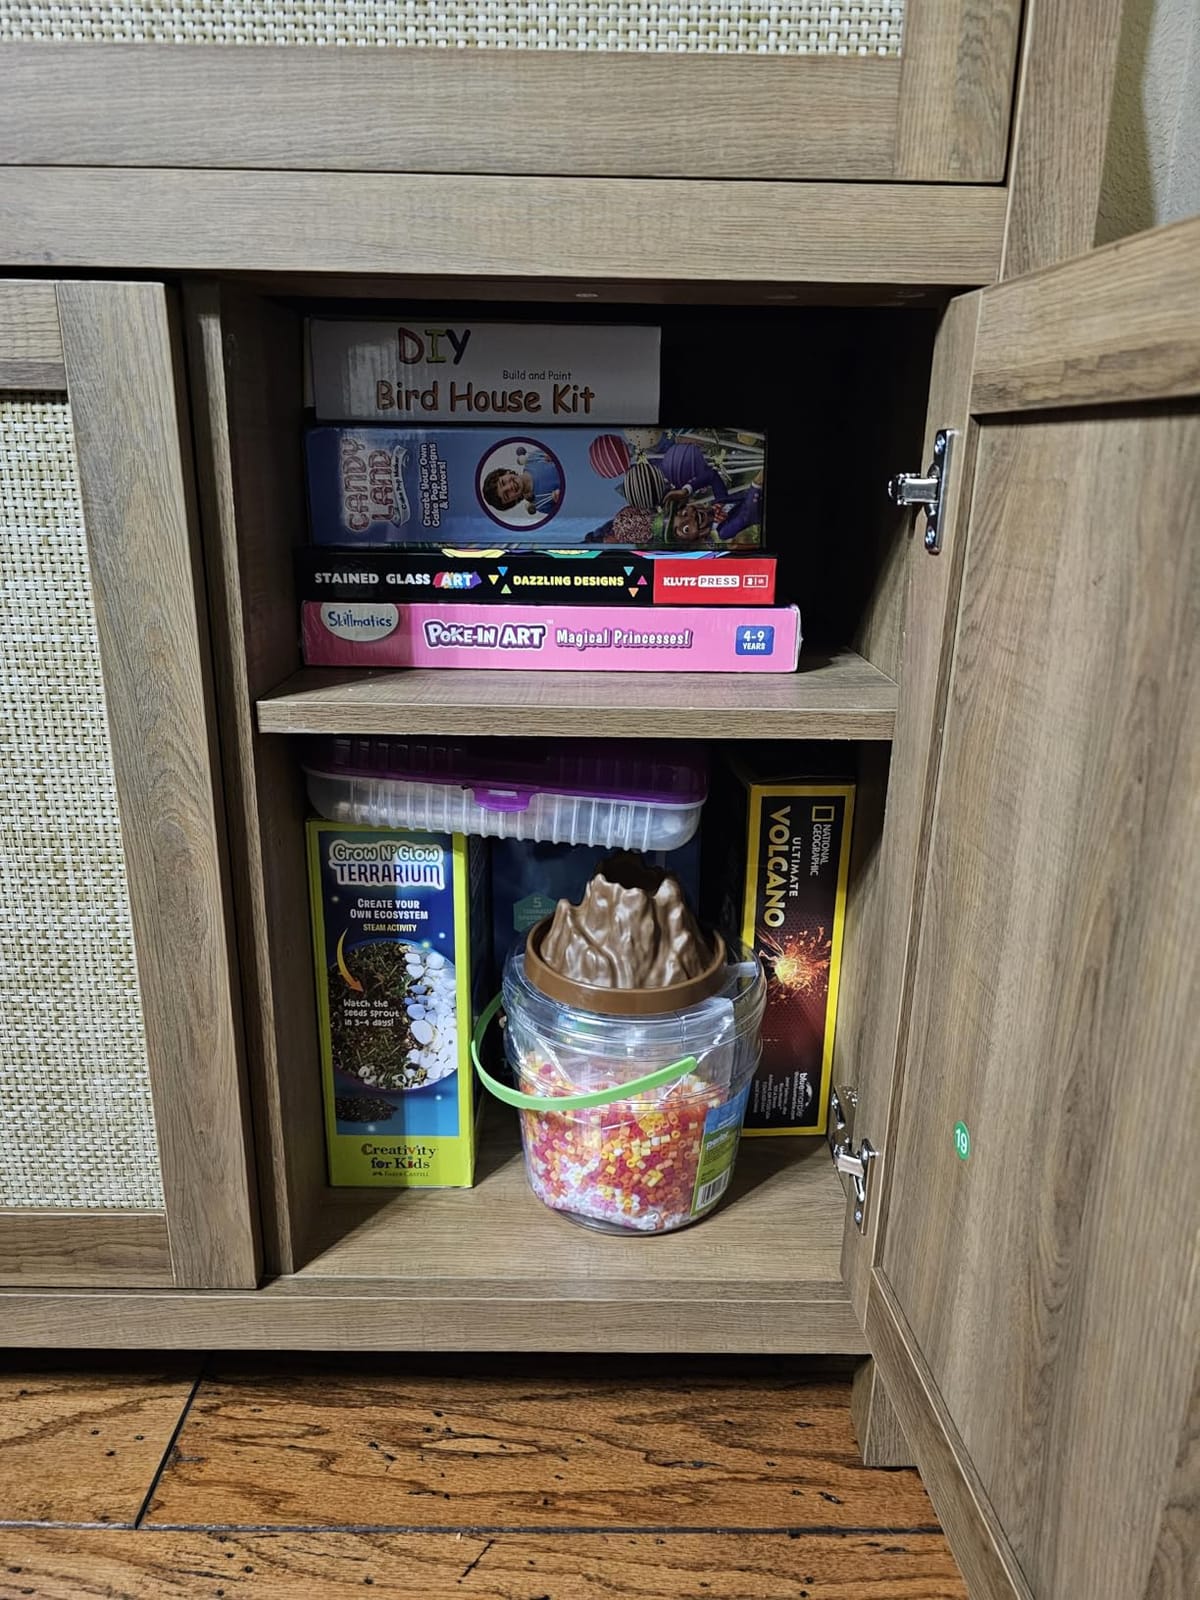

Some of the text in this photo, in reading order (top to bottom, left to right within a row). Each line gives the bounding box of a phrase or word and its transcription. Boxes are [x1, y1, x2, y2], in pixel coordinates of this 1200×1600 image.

[397, 327, 471, 365] DIY
[502, 369, 572, 381] Build and Paint
[376, 380, 595, 414] Bird House Kit
[342, 438, 370, 530] CANDY
[368, 450, 395, 520] LAND
[420, 444, 432, 527] Create Your Own
[429, 443, 441, 527] Cake Pop Designs
[437, 461, 449, 509] & Flavors!
[315, 572, 624, 587] STAINED GLASS ART DAZZLING DESIGNS
[663, 576, 739, 587] KLUTZ PRESS
[327, 609, 393, 627] Skillmatics
[501, 628, 545, 646] ART
[556, 629, 690, 648] Magical Princesses!
[743, 630, 765, 641] 4-9
[742, 642, 766, 650] YEARS
[809, 823, 822, 876] GEOGRAPHIC
[820, 824, 832, 864] NATIONAL
[333, 862, 441, 885] TERRARIUM
[764, 805, 791, 927] VOLCANO
[789, 837, 802, 897] ULTIMATE
[357, 899, 420, 909] CREATE YOUR
[350, 909, 428, 920] OWN ECOSYSTEM
[363, 923, 417, 932] STEAM ACTIVITY
[343, 998, 370, 1007] Watch
[343, 1009, 400, 1018] seeds sprout
[344, 1018, 352, 1026] in
[372, 1018, 394, 1027] days!
[955, 1128, 968, 1154] 19
[361, 1143, 437, 1159] Creativity
[371, 1155, 431, 1169] for Kids
